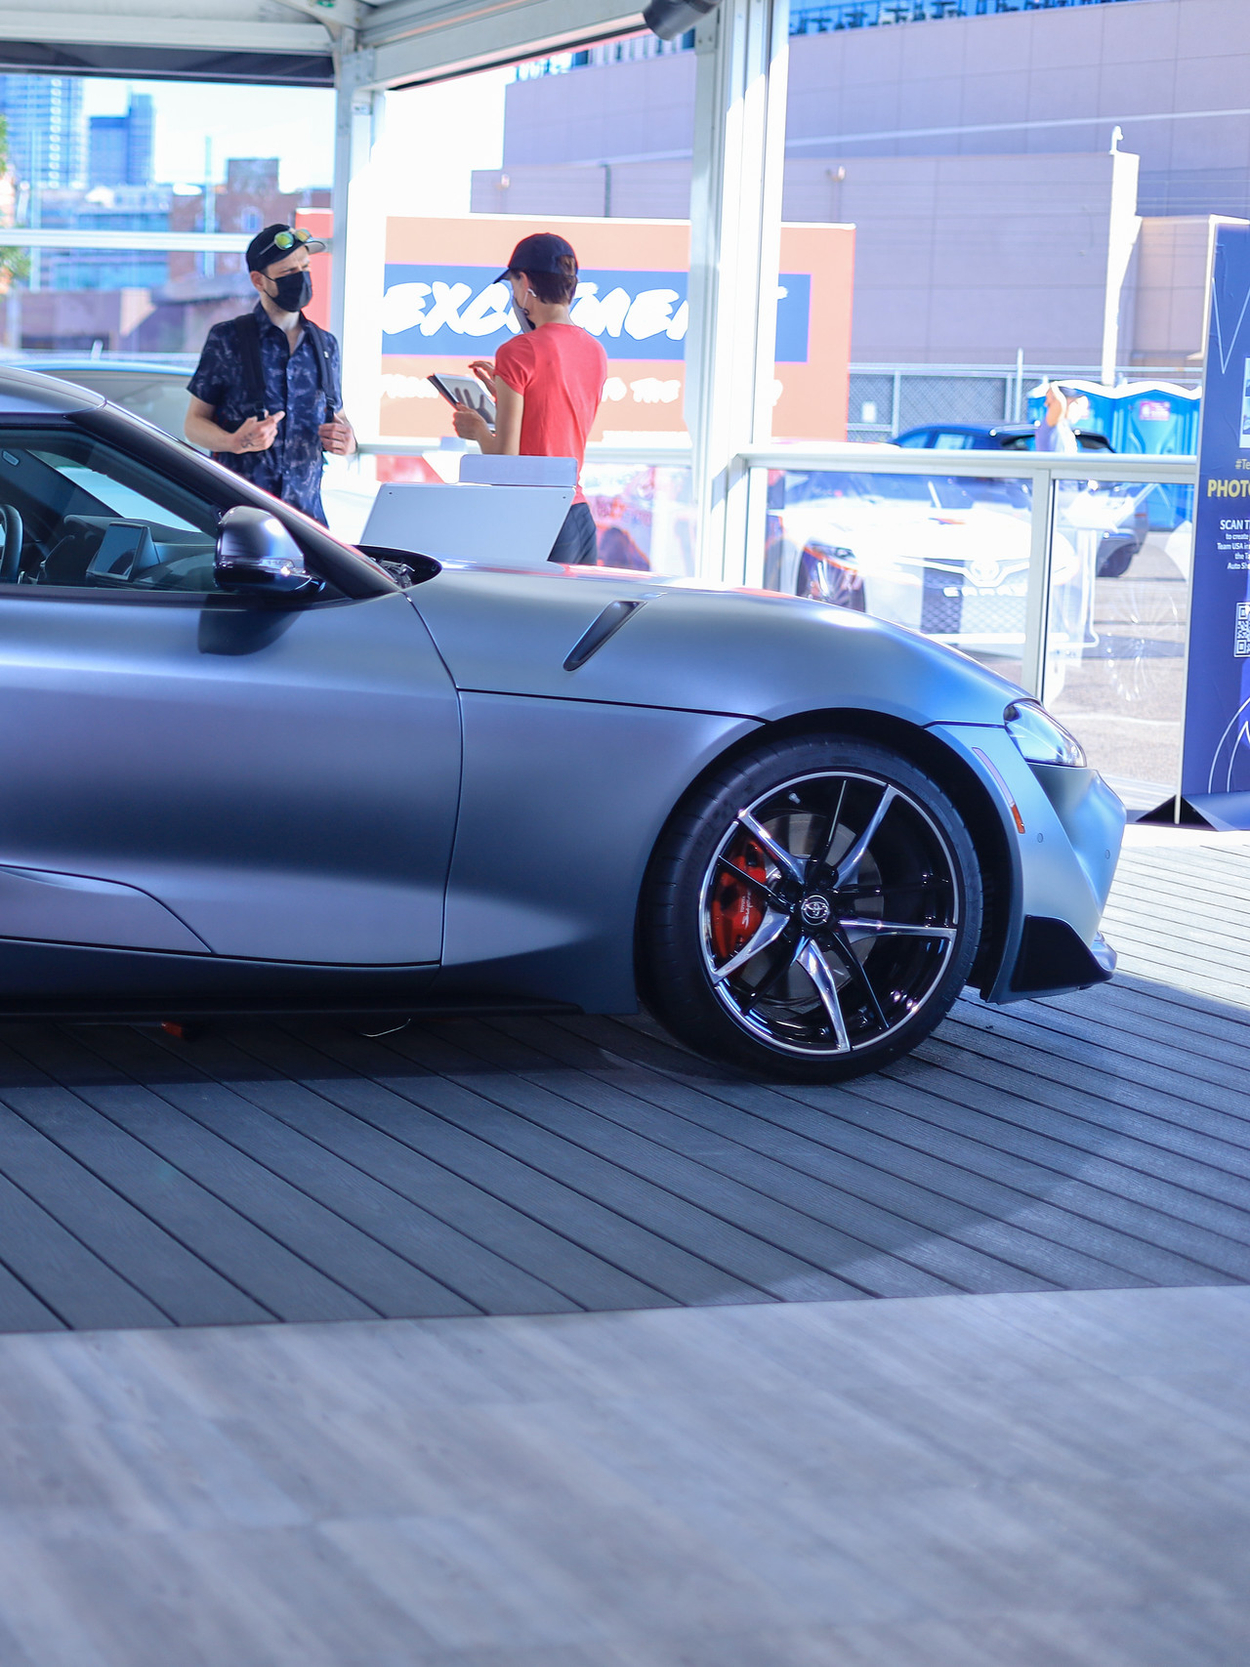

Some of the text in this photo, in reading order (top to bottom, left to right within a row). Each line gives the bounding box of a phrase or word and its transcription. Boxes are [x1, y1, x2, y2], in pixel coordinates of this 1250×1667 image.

[1207, 479, 1250, 498] PHOT
[1219, 519, 1243, 530] SCAN
[1232, 542, 1244, 550] USA
